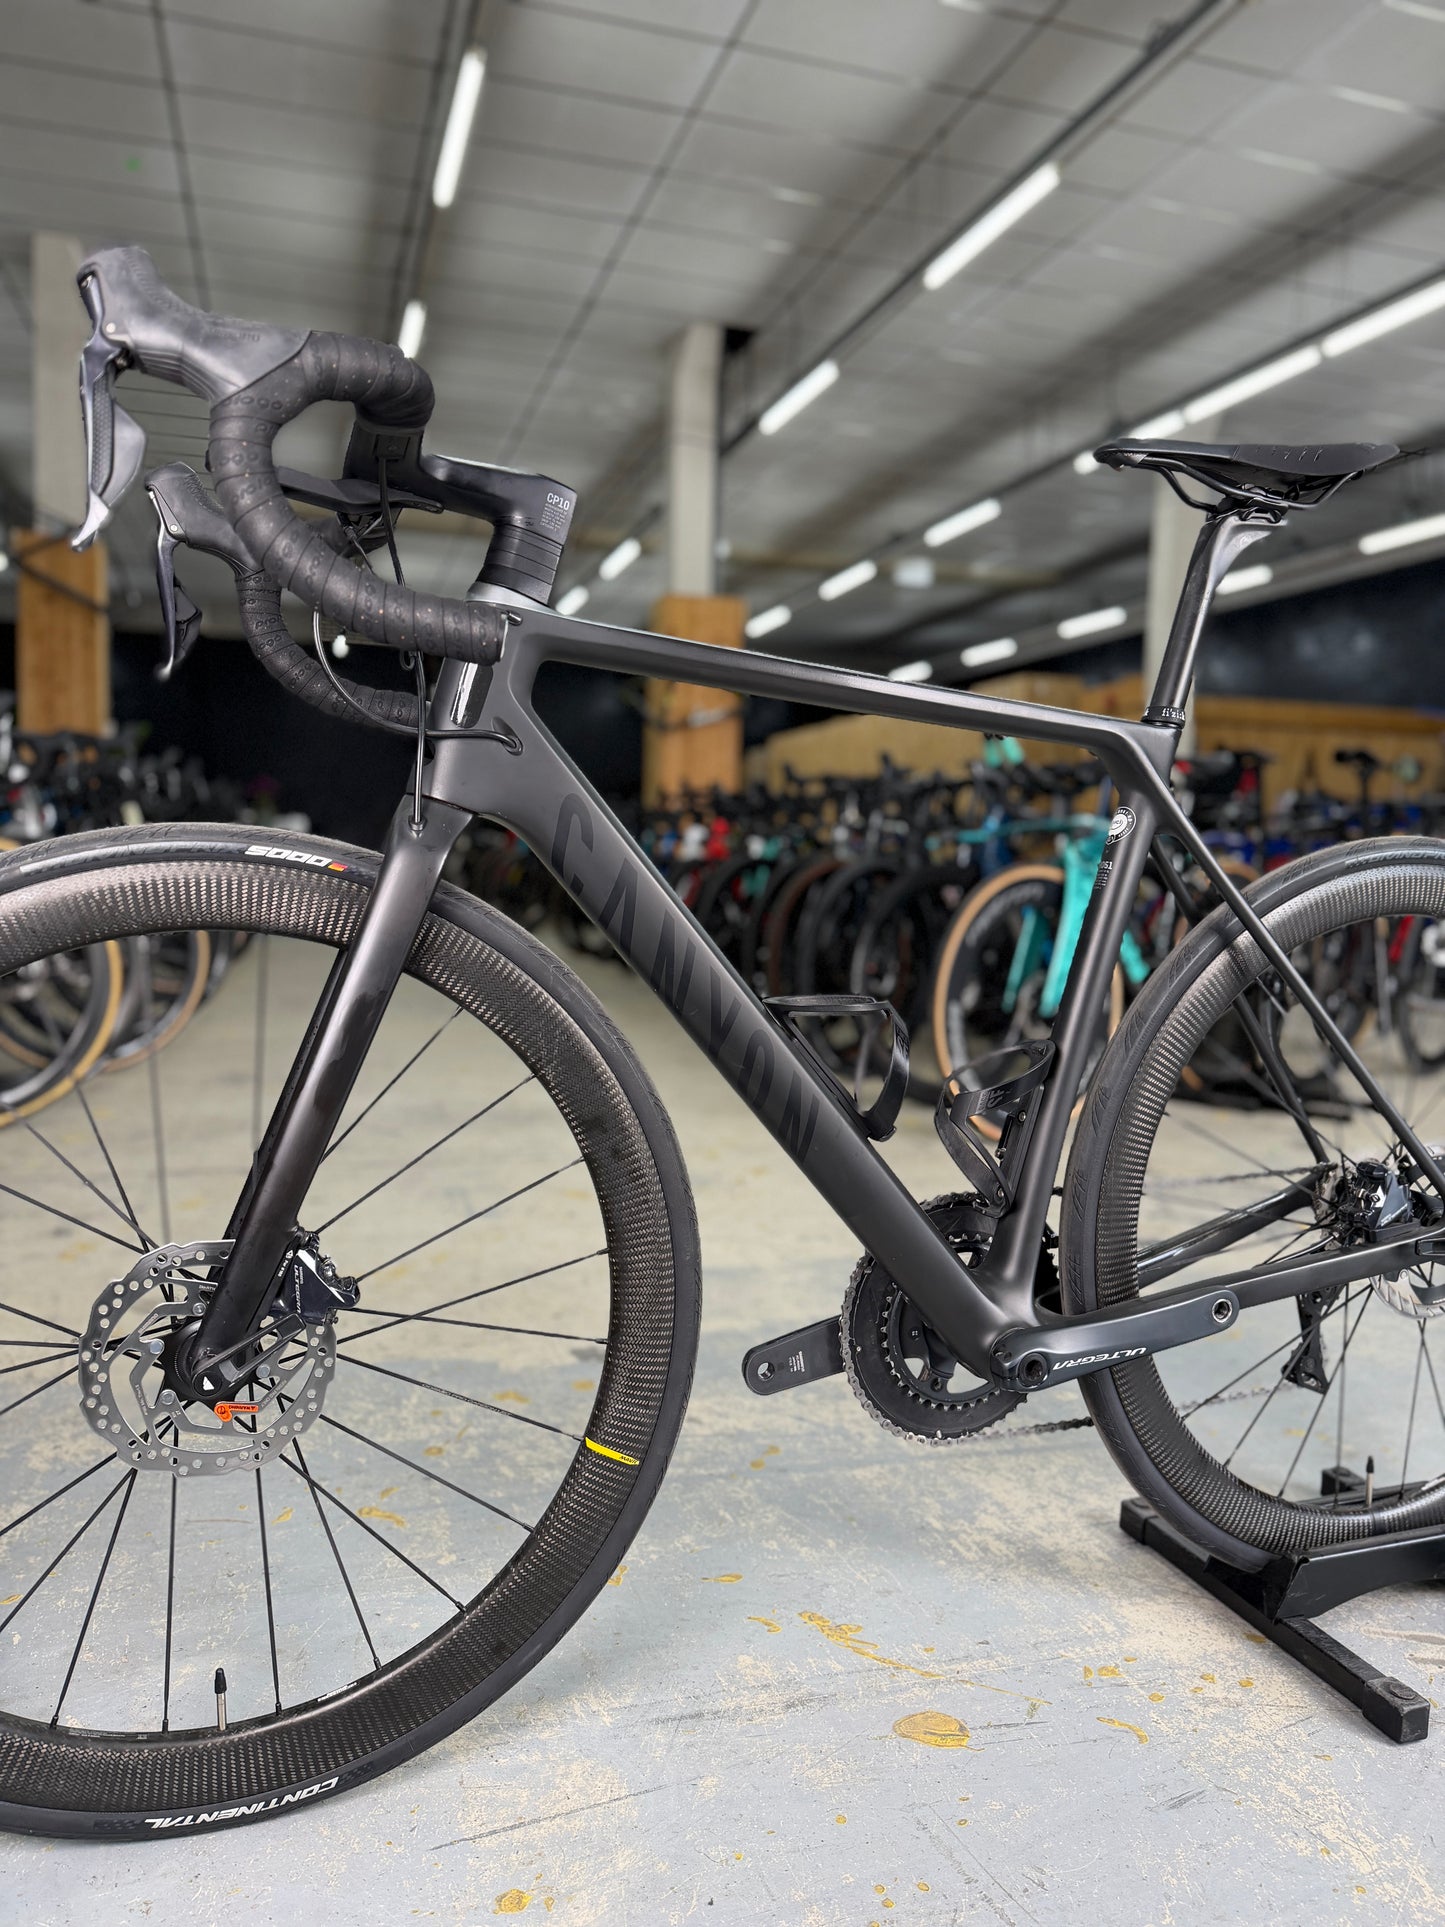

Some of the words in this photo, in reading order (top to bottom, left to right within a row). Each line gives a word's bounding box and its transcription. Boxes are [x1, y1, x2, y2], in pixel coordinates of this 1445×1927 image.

[547, 492, 570, 511] CP10
[244, 845, 333, 868] 5000
[551, 793, 819, 1164] CANYON
[1052, 1347, 1147, 1371] ULTEGRA
[145, 1776, 339, 1829] CONTINENTAL
